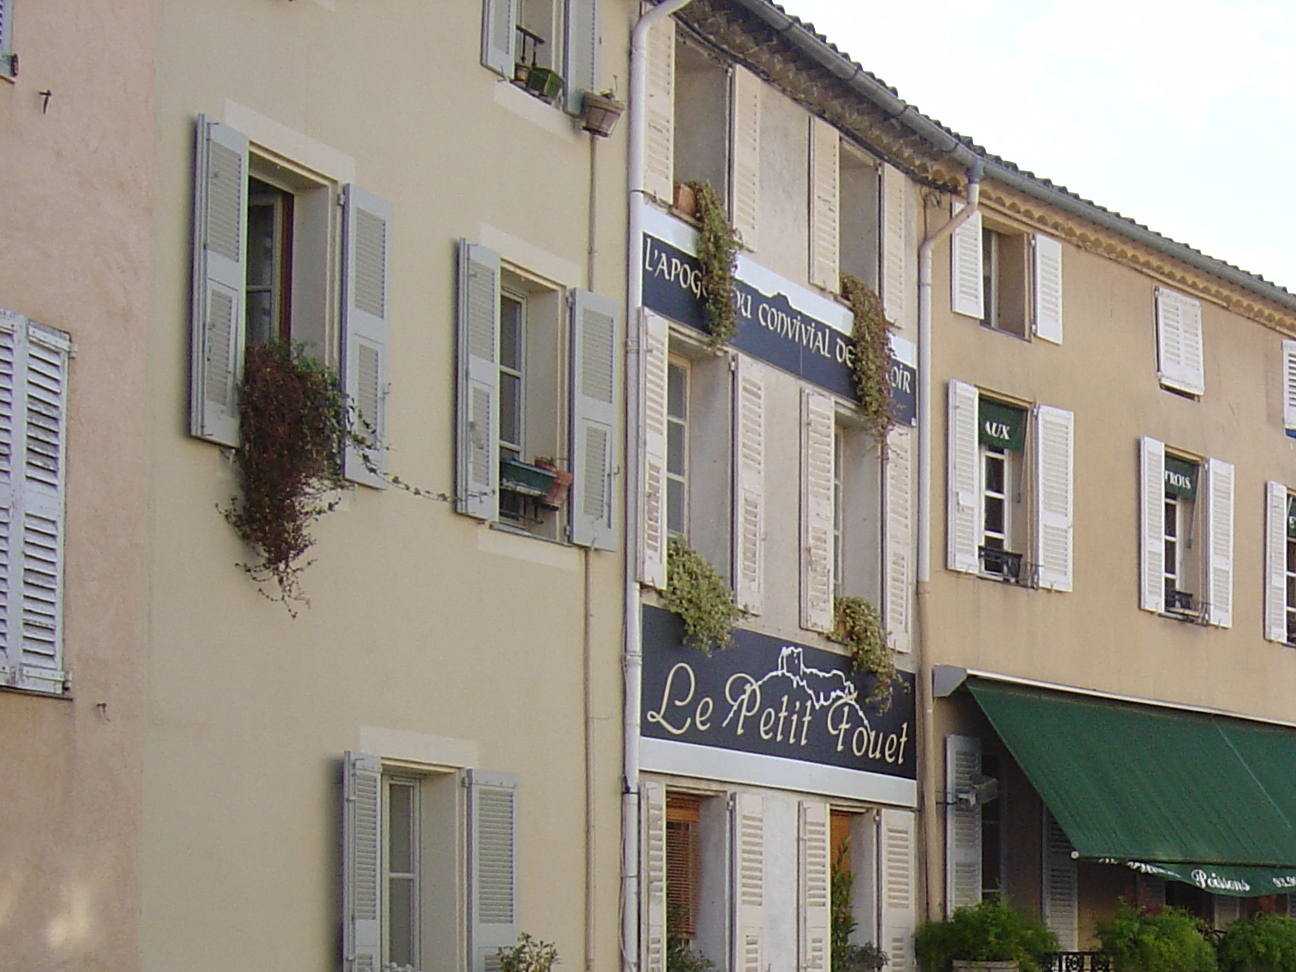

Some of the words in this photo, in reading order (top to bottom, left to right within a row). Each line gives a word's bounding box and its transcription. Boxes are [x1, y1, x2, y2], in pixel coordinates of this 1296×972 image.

[645, 238, 707, 299] L'APOG
[886, 364, 911, 394] OIR
[984, 421, 1010, 440] AUX
[1164, 470, 1191, 489] TROIS
[647, 662, 713, 735] Le
[725, 672, 812, 746] Petit
[827, 691, 908, 765] Fouet
[1191, 868, 1250, 892] Poissons
